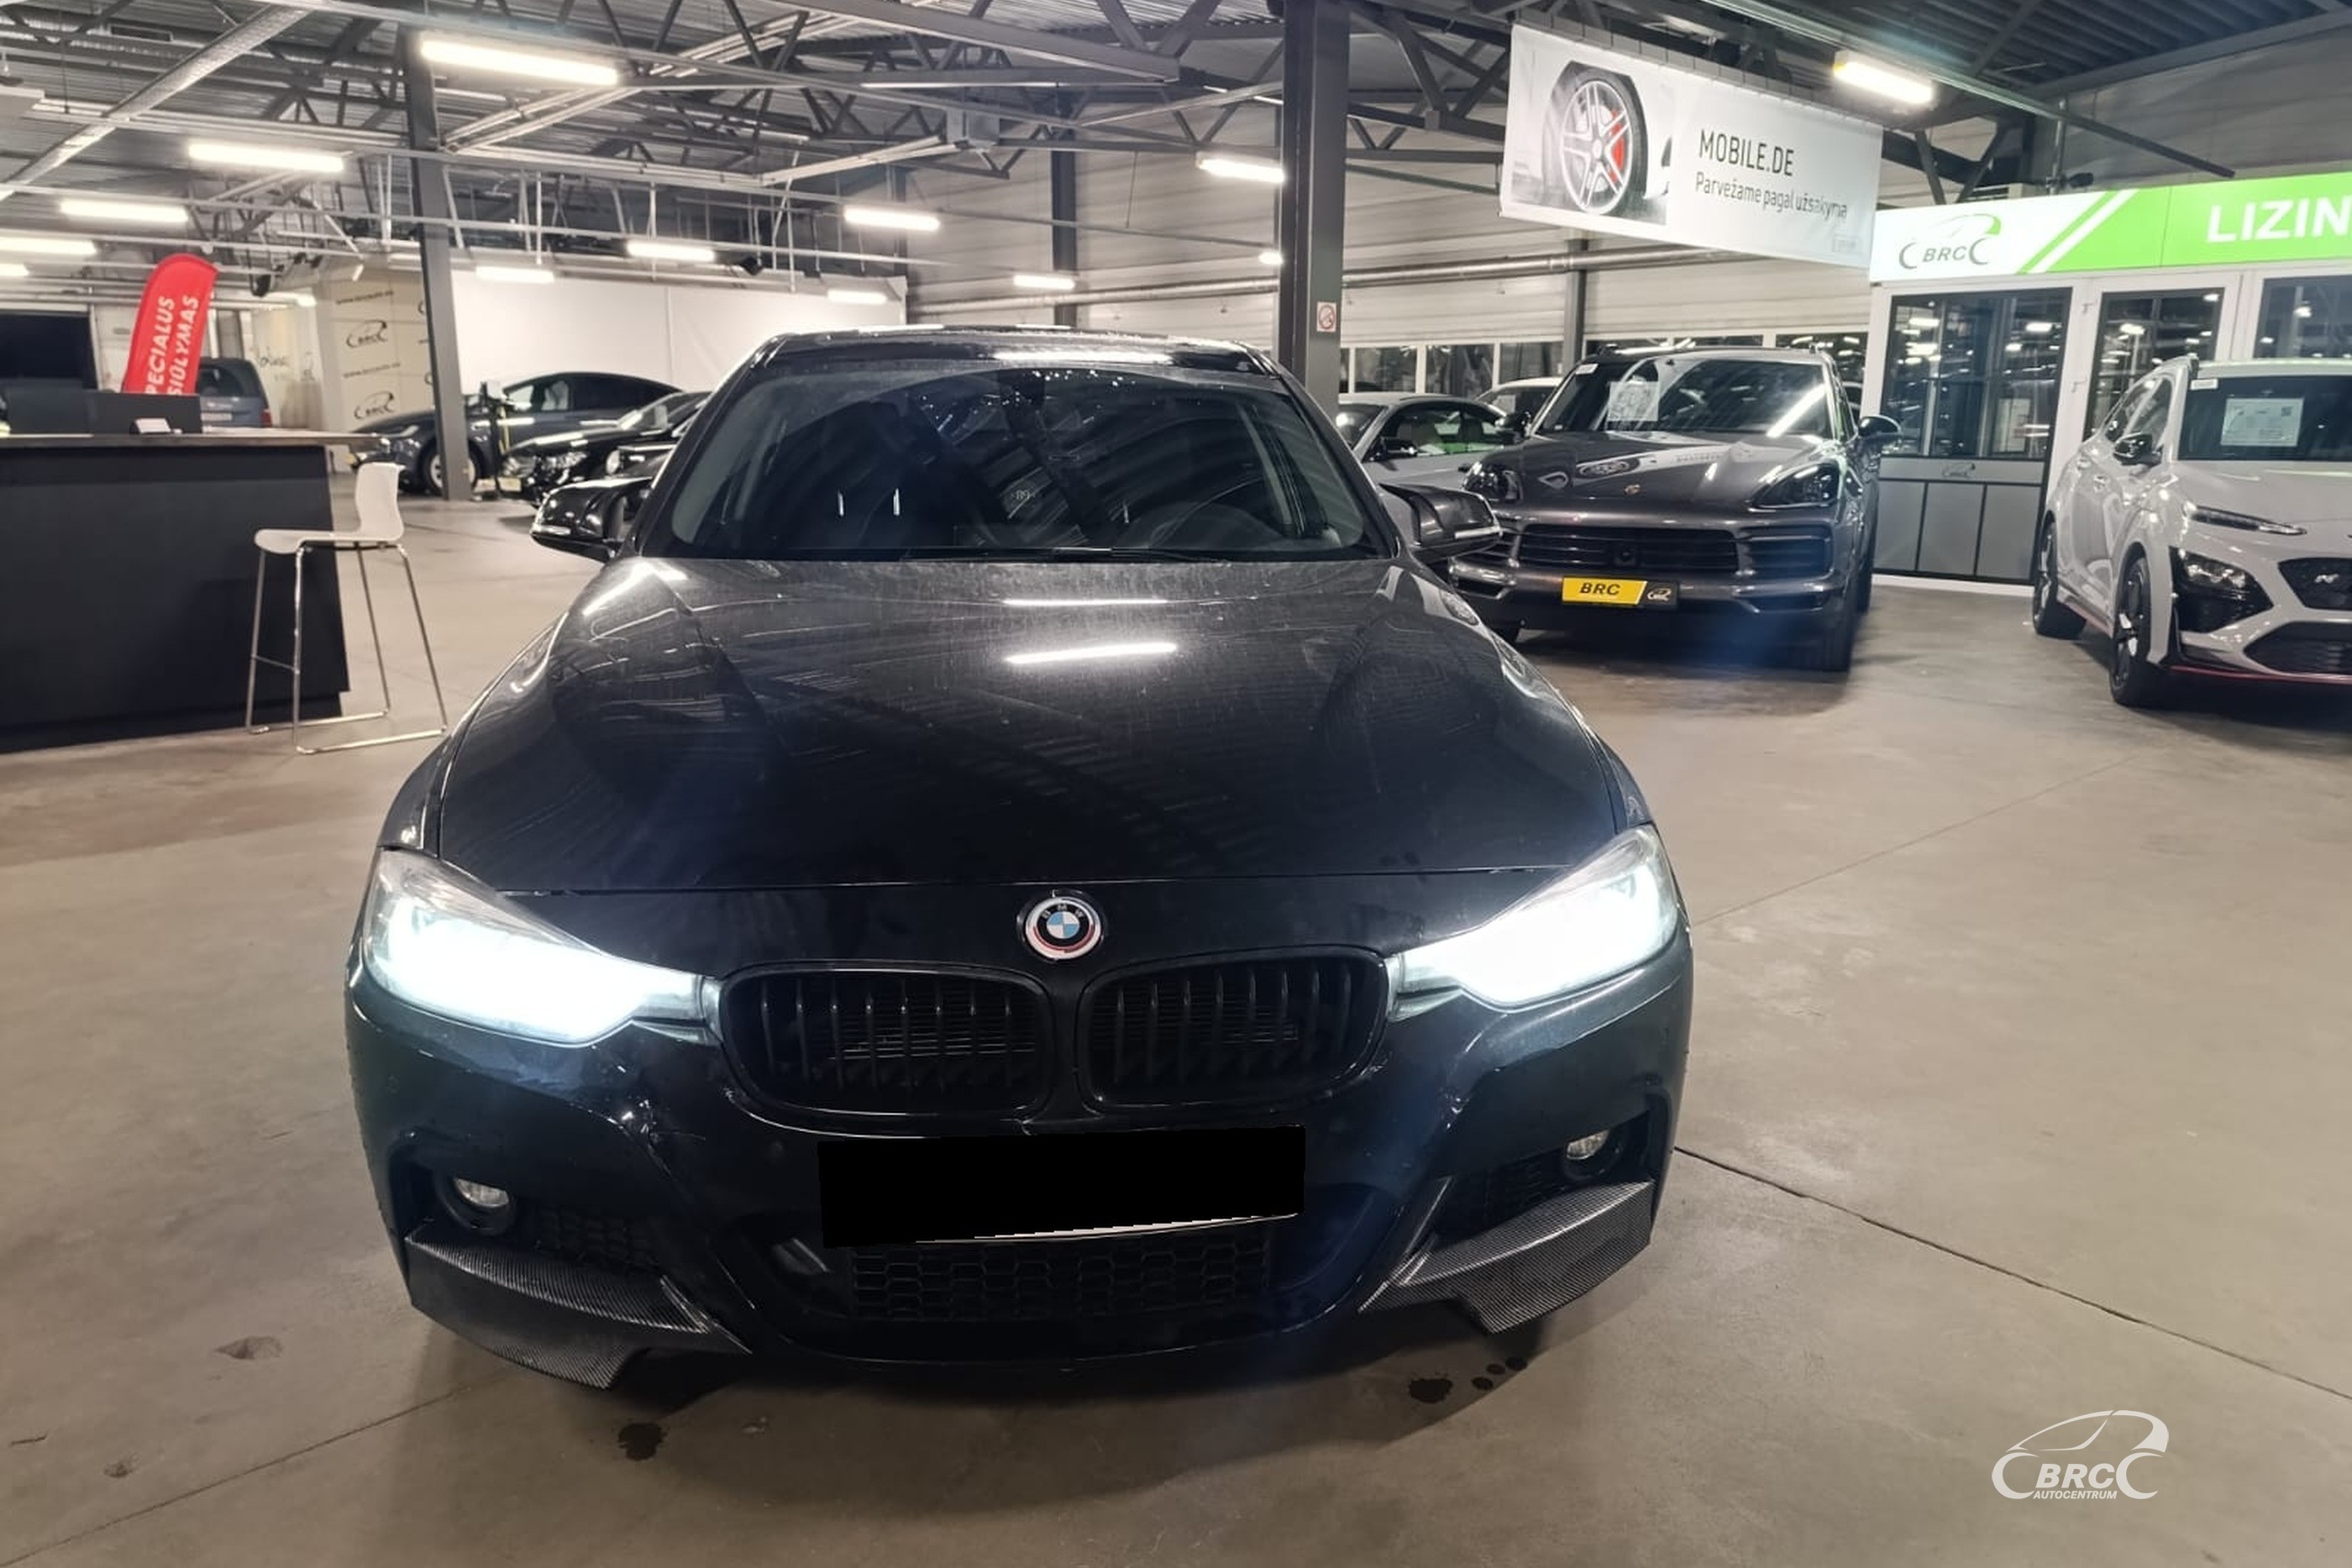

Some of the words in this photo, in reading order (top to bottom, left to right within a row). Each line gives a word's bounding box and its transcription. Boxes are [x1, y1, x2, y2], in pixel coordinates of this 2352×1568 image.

[1698, 128, 1794, 176] MOBILE.DE
[1695, 170, 1763, 202] Parvežame
[1763, 188, 1794, 212] pagal
[1923, 245, 1966, 262] BRC
[1579, 581, 1621, 595] BRC
